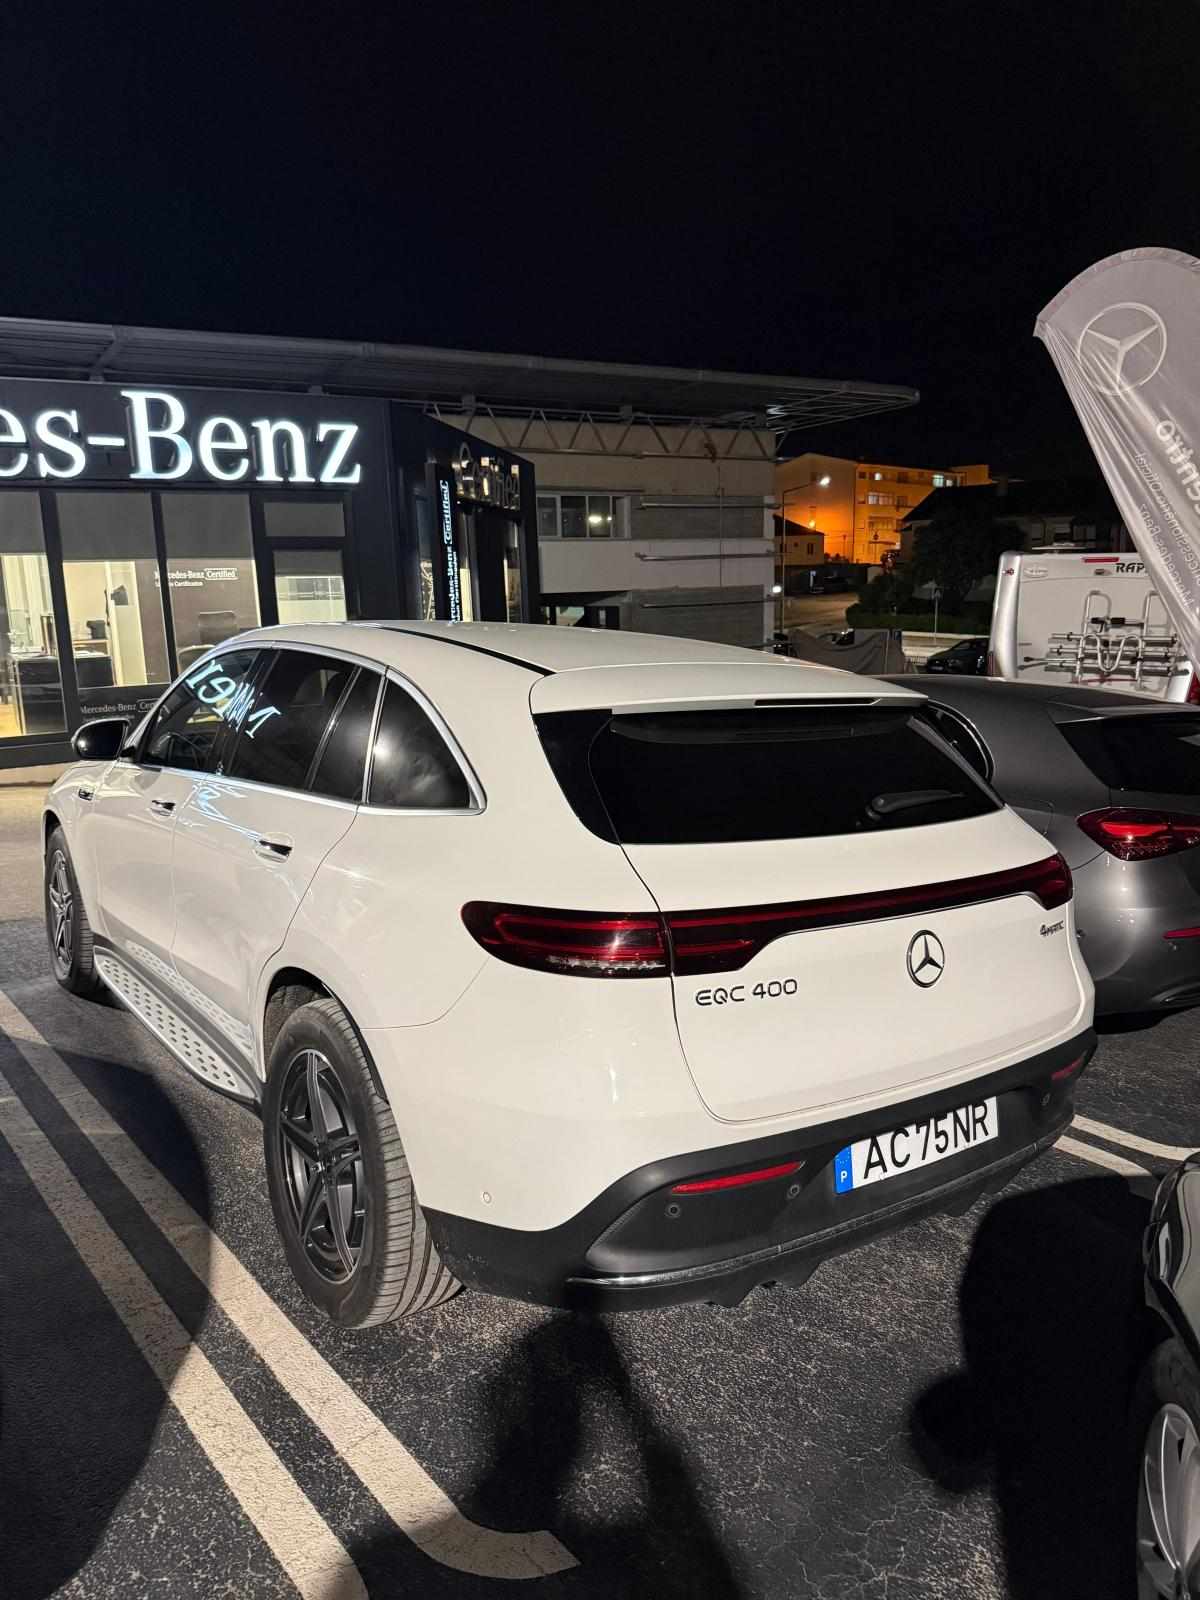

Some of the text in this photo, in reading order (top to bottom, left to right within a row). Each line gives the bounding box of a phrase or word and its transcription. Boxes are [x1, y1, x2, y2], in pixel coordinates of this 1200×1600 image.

[1115, 562, 1149, 575] RAP
[80, 703, 137, 714] Mercedes-Benz
[696, 979, 798, 1006] EQC 400
[840, 1170, 848, 1183] P
